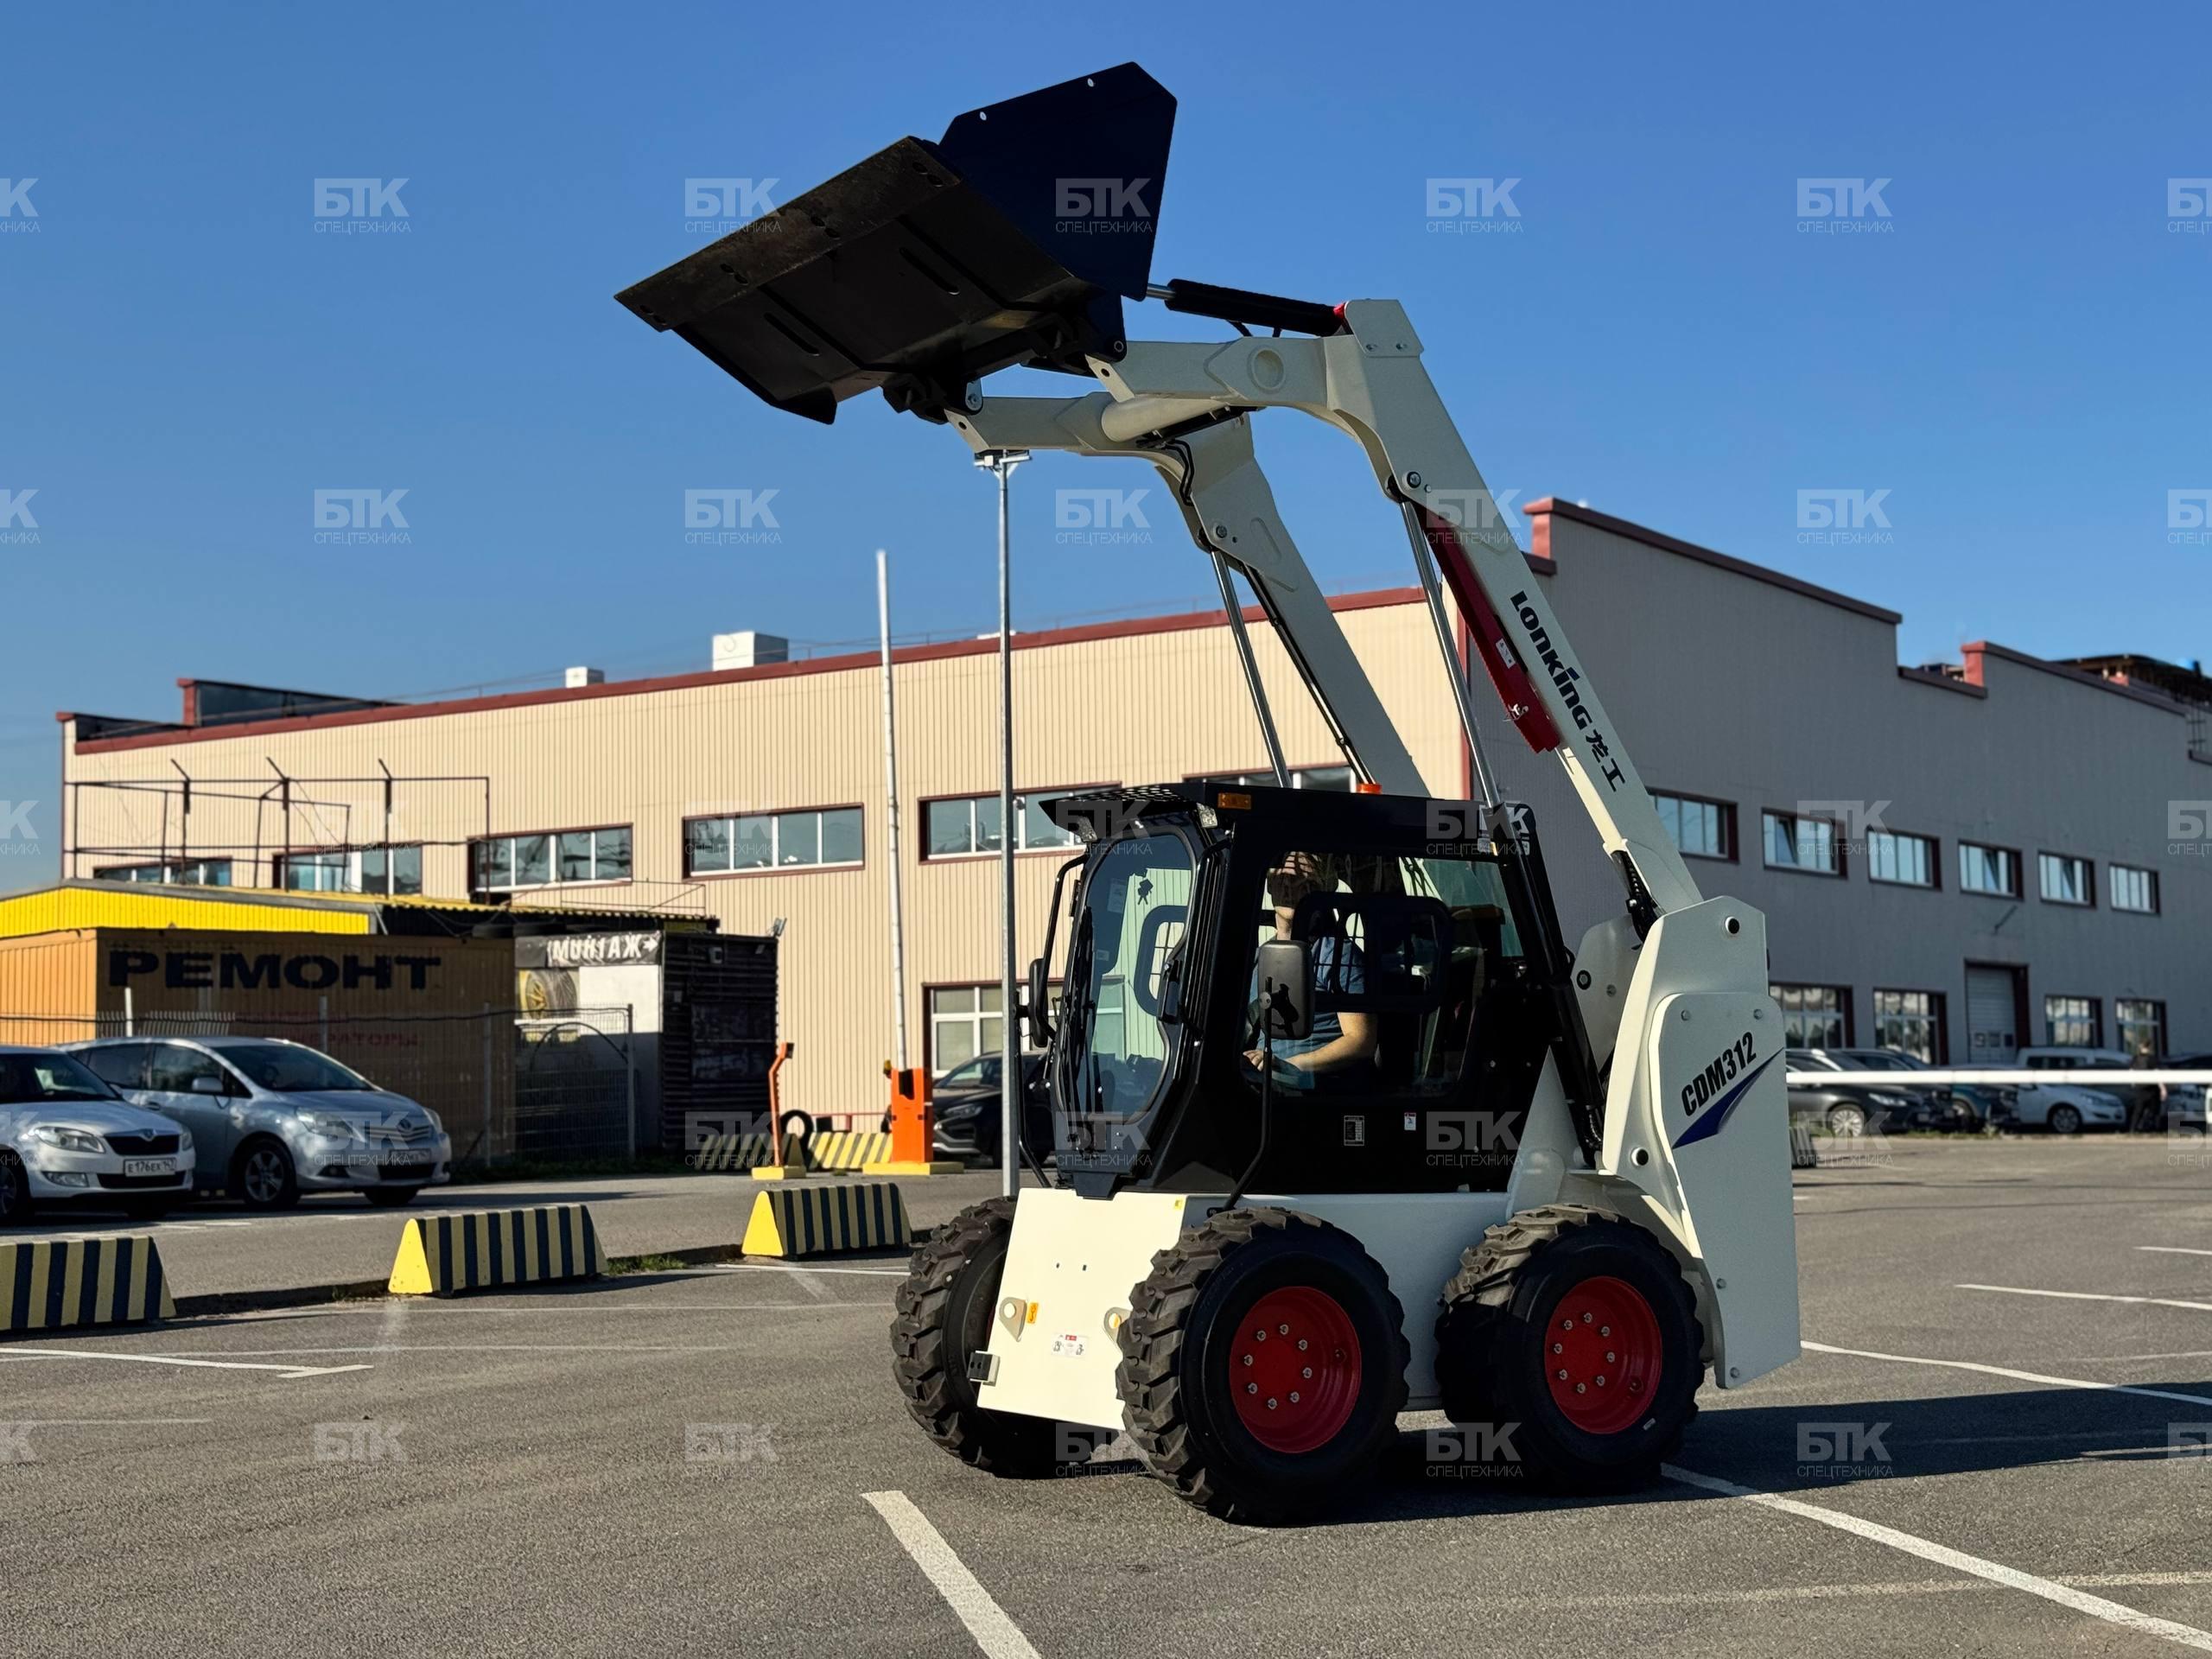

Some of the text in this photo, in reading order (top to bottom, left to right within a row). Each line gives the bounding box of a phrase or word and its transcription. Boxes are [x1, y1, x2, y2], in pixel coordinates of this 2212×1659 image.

[1586, 729, 1625, 791] 龙工
[110, 950, 441, 989] РЕМОНТ
[1681, 1032, 1757, 1116] CDM312
